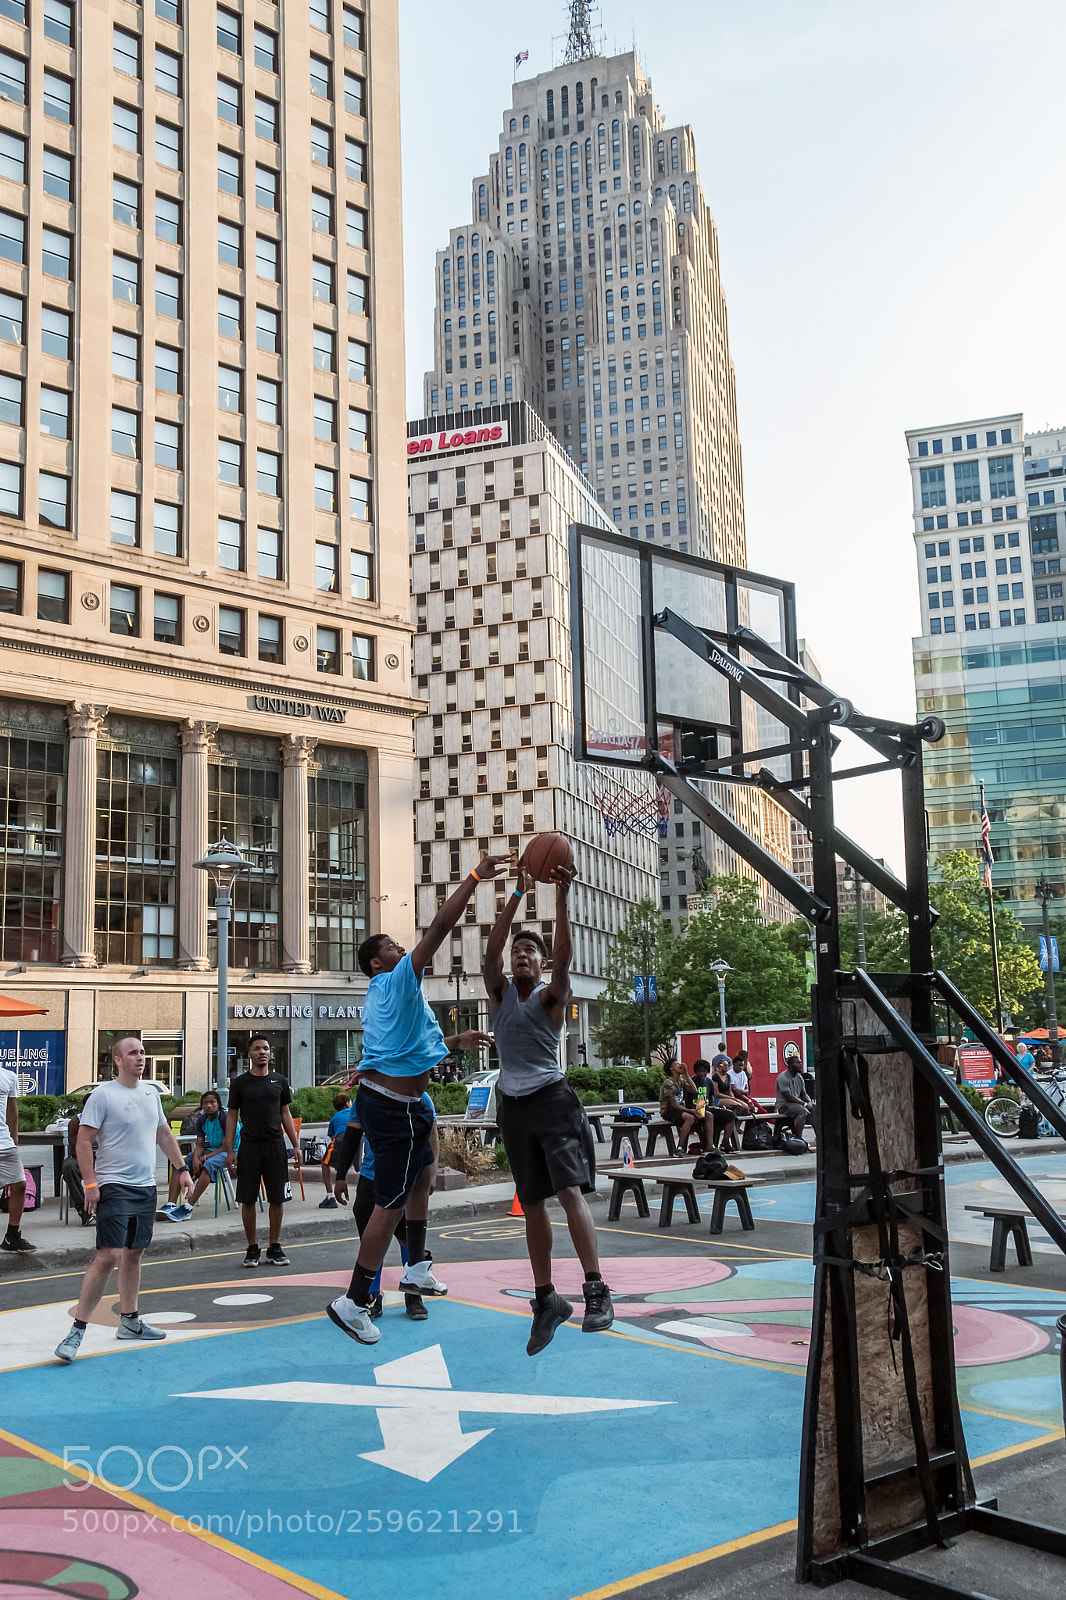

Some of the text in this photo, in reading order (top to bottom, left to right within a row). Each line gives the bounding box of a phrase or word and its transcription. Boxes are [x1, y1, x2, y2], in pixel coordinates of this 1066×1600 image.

[407, 426, 502, 454] en Loans
[709, 649, 744, 683] SPALDING
[254, 695, 348, 723] UNITED WAY
[234, 1005, 364, 1018] ROASTING PLANT
